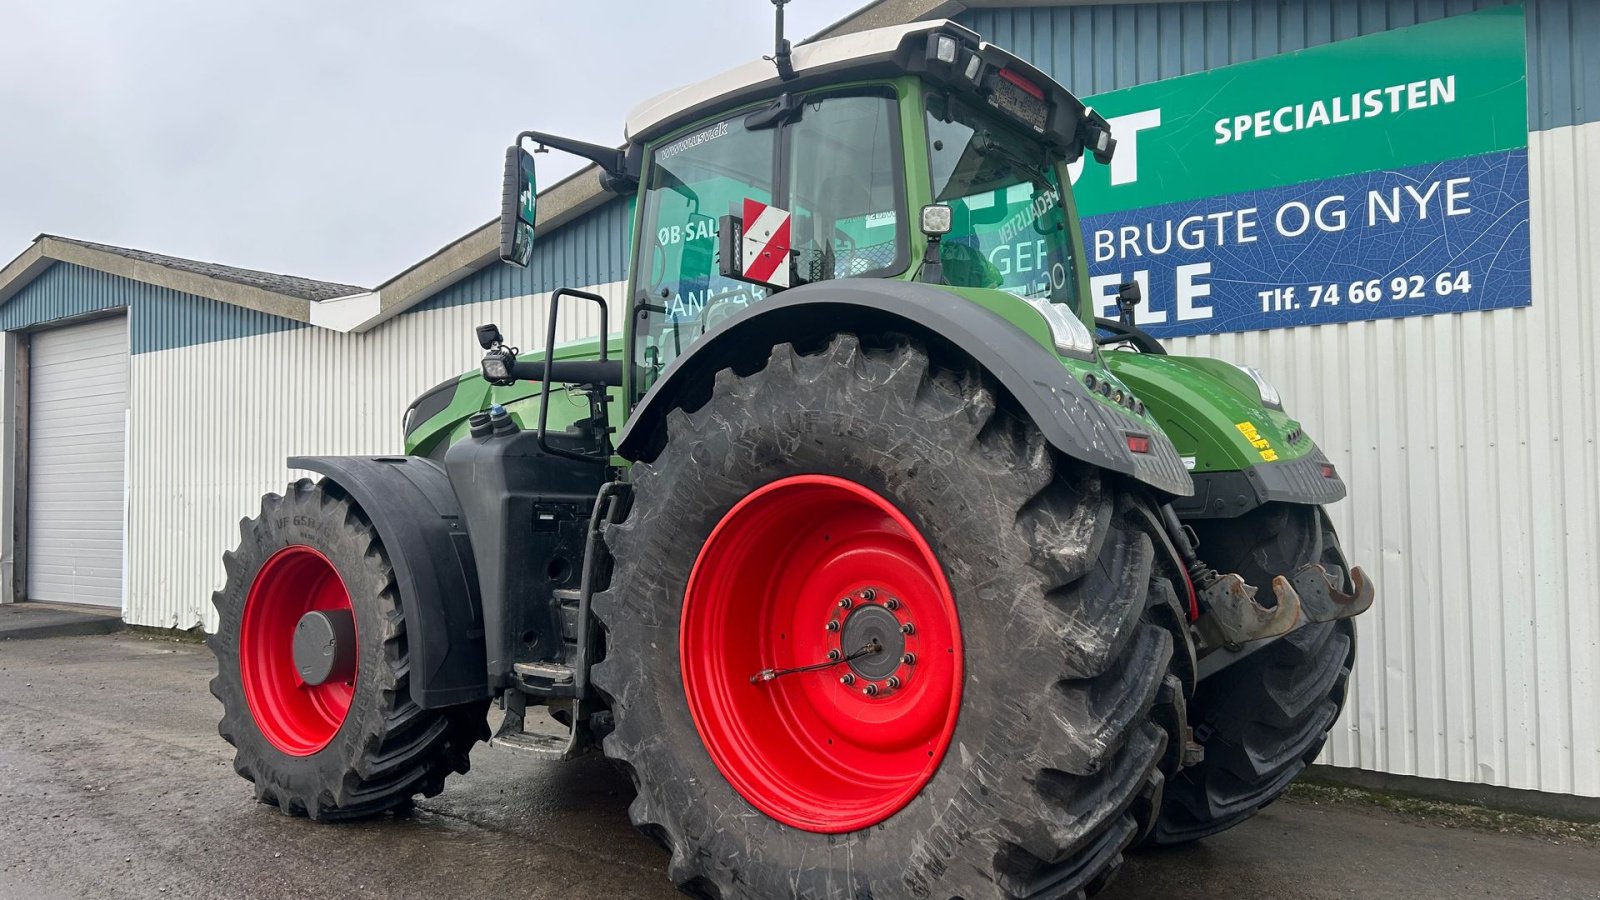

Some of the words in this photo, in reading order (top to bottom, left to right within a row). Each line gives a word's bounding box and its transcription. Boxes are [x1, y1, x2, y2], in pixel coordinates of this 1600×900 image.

[1214, 75, 1456, 145] SPECIALISTEN
[1094, 206, 1258, 262] BRUGTE
[1275, 195, 1346, 237] OG
[1368, 177, 1472, 226] NYE
[1258, 288, 1300, 313] Tlf.
[1308, 283, 1340, 308] 74
[1348, 279, 1382, 303] 66
[1391, 275, 1425, 299] 92
[1435, 270, 1472, 295] 64
